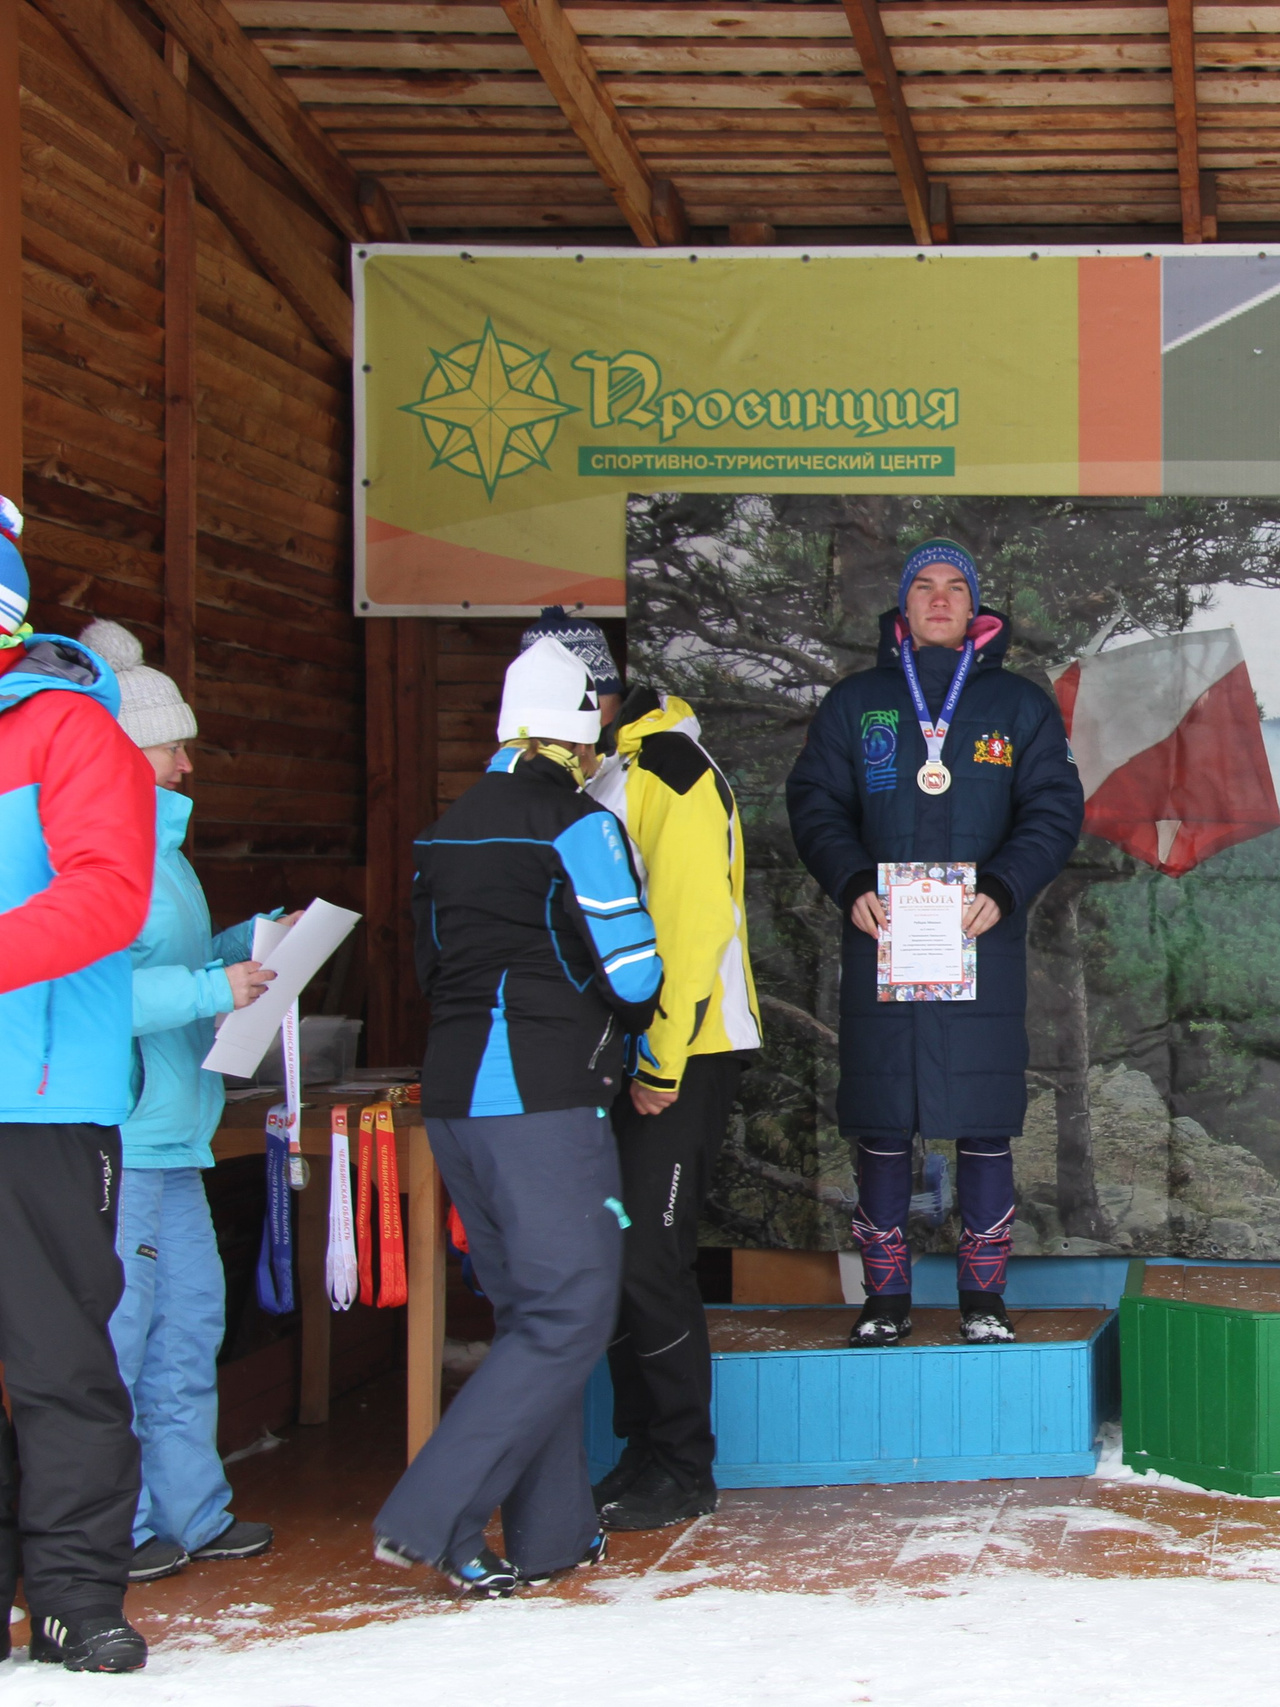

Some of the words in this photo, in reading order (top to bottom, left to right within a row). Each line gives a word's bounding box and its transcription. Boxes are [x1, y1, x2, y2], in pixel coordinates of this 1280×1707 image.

[570, 350, 959, 443] Провинция
[591, 451, 875, 471] СПОРТИВНО-ТУРИСТИЧЕСКИЙ
[879, 454, 943, 472] ЦЕНТР
[898, 895, 954, 904] ГРАМОТА
[339, 1148, 348, 1204] ЧЕЛЯБИНСКАЯ
[381, 1145, 389, 1202] ЧЕЛЯБИНСКАЯ
[668, 1163, 682, 1210] NORD
[282, 1209, 290, 1245] ОБЛАСТЬ
[342, 1205, 351, 1241] ОБЛАСТЬ
[383, 1203, 391, 1239] ОБЛАСТЬ
